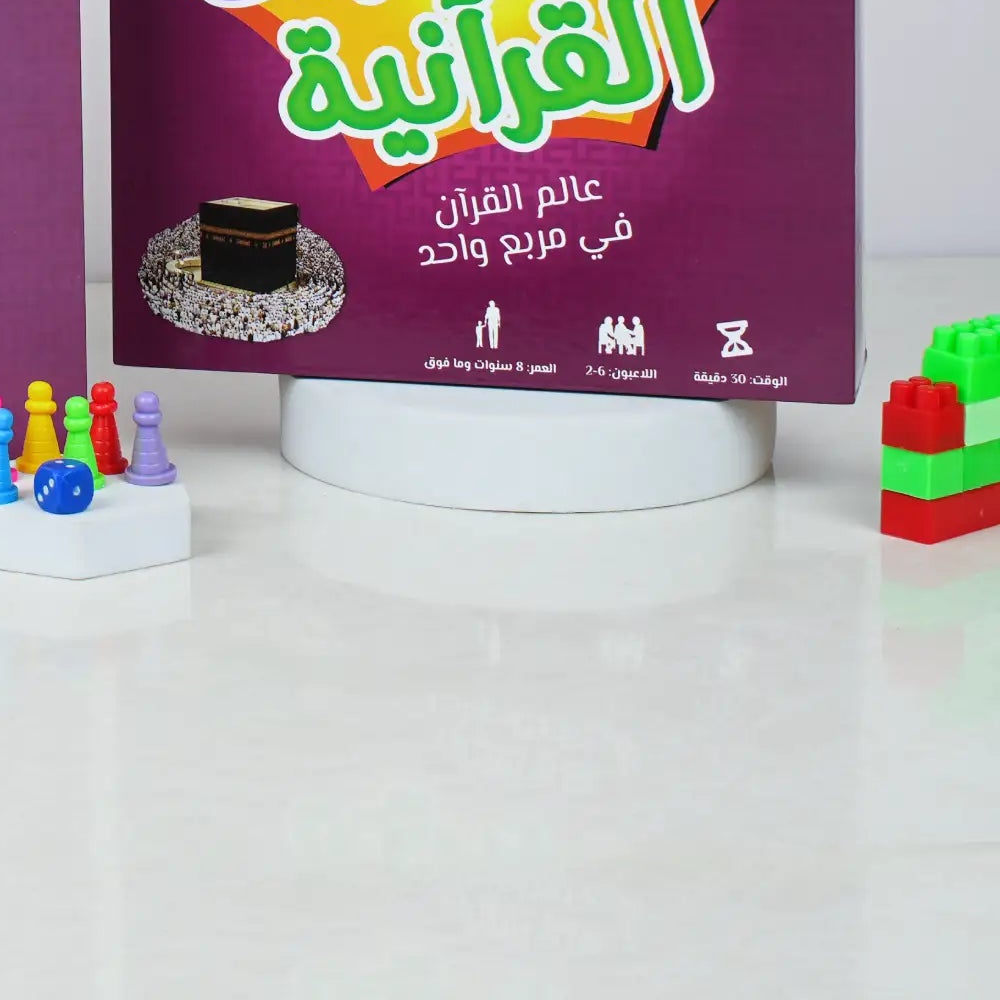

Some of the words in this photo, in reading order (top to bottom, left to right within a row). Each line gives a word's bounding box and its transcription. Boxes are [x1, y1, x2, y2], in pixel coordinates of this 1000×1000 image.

[537, 175, 603, 219] عالم
[435, 183, 523, 230] القرآن
[579, 211, 633, 261] في
[418, 233, 489, 268] واحد
[499, 227, 567, 266] مربع
[423, 356, 451, 370] فوق
[453, 357, 472, 372] وما
[474, 359, 513, 373] سنوات
[515, 361, 524, 372] 8
[526, 362, 557, 376] العمر:
[693, 371, 728, 385] دقيقة
[730, 373, 747, 385] 30
[749, 374, 788, 389] الوقت:
